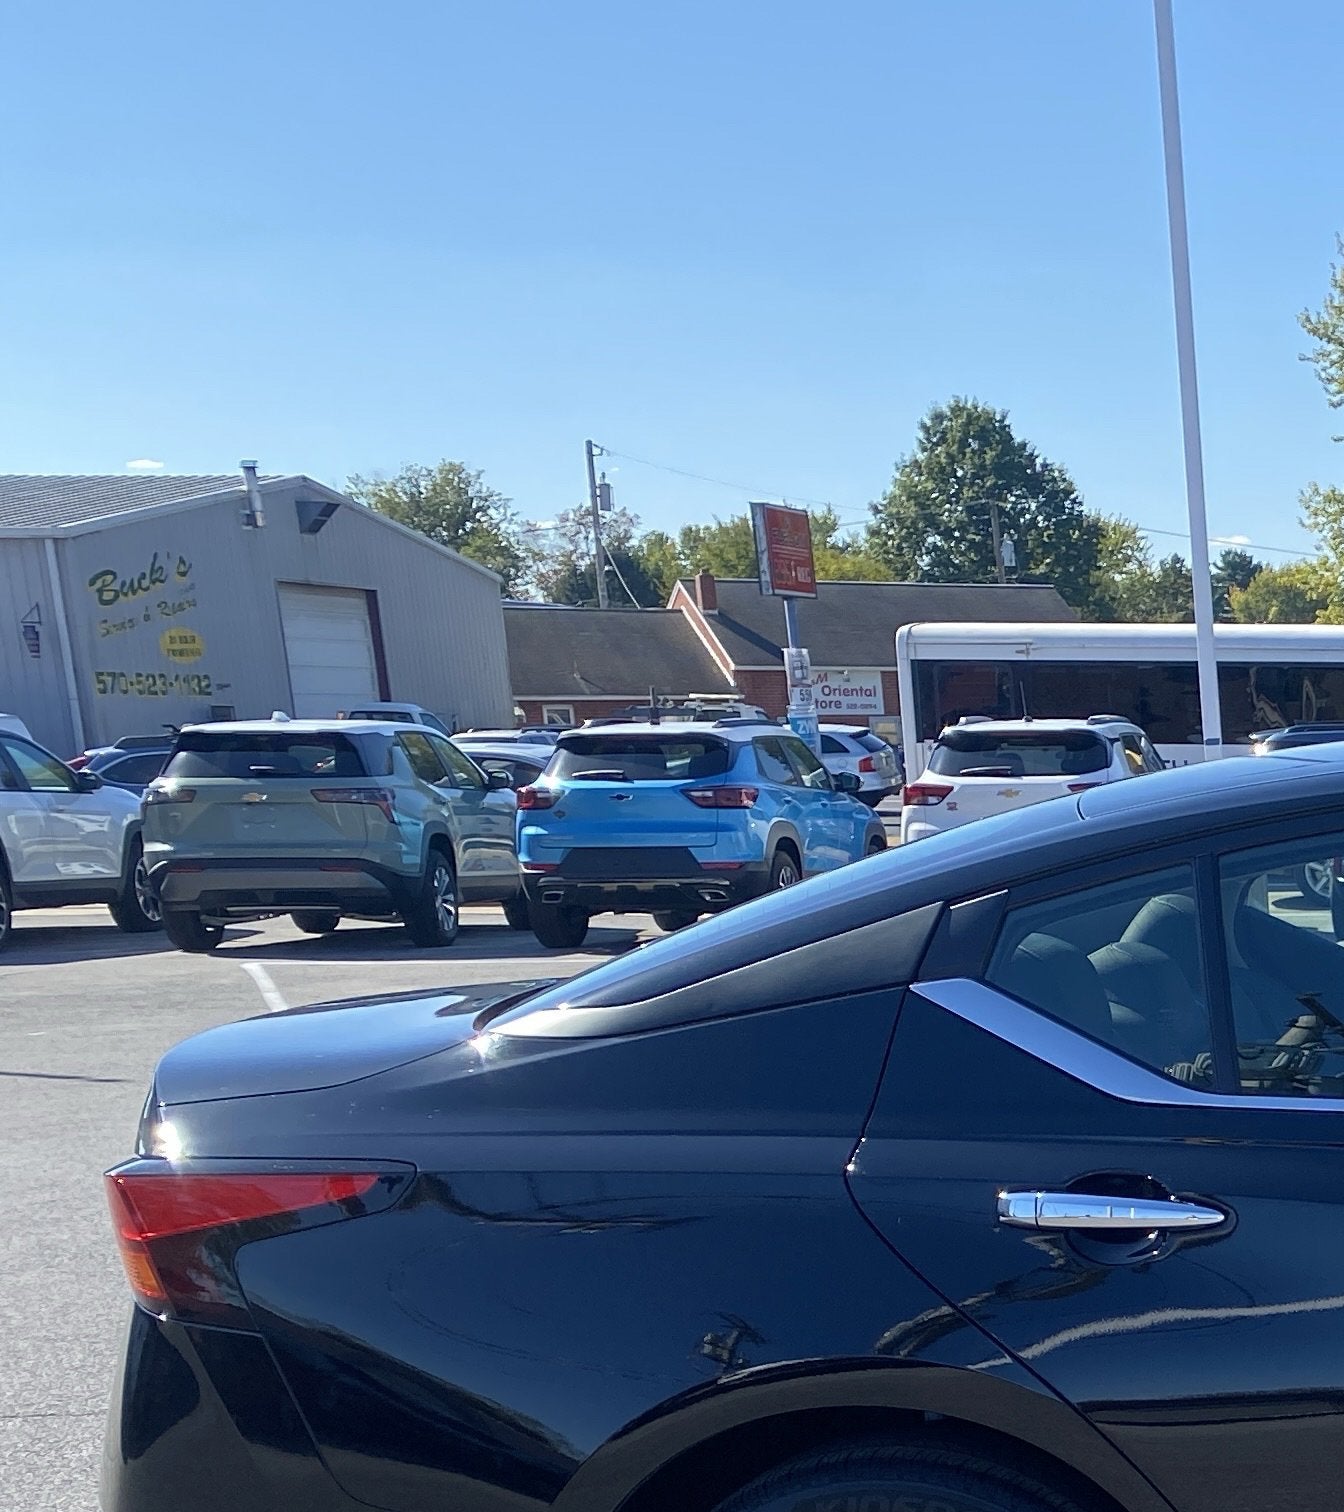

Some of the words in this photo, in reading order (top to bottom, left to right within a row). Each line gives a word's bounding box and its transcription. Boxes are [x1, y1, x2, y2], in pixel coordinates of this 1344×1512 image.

[88, 552, 193, 606] Buck's
[821, 685, 877, 698] Oriental
[815, 698, 843, 709] tore
